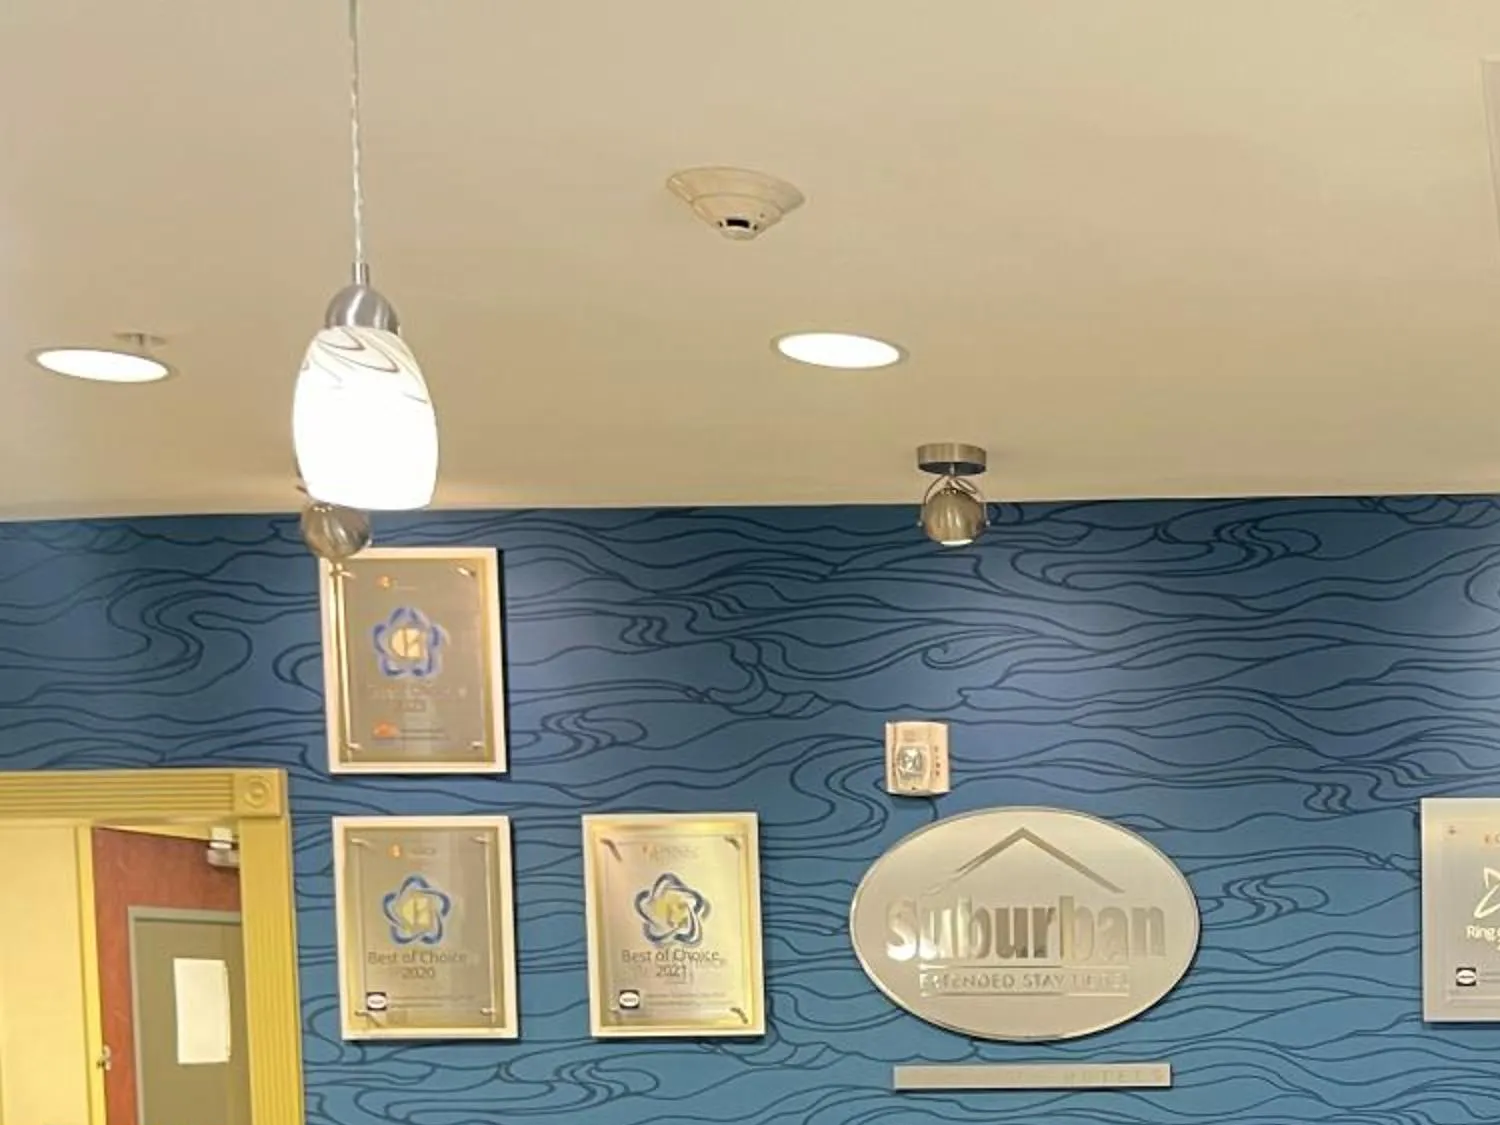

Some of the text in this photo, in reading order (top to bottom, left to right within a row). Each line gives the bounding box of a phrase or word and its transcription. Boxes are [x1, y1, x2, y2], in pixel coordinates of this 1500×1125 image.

[886, 895, 1168, 961] Suburban
[1466, 924, 1496, 942] Ring
[367, 950, 468, 964] Best of Choice
[622, 948, 719, 962] Best of Choice
[401, 966, 436, 979] 2020
[656, 964, 687, 977] 2021
[919, 972, 1015, 990] EXTENDED
[1023, 972, 1066, 990] STAY
